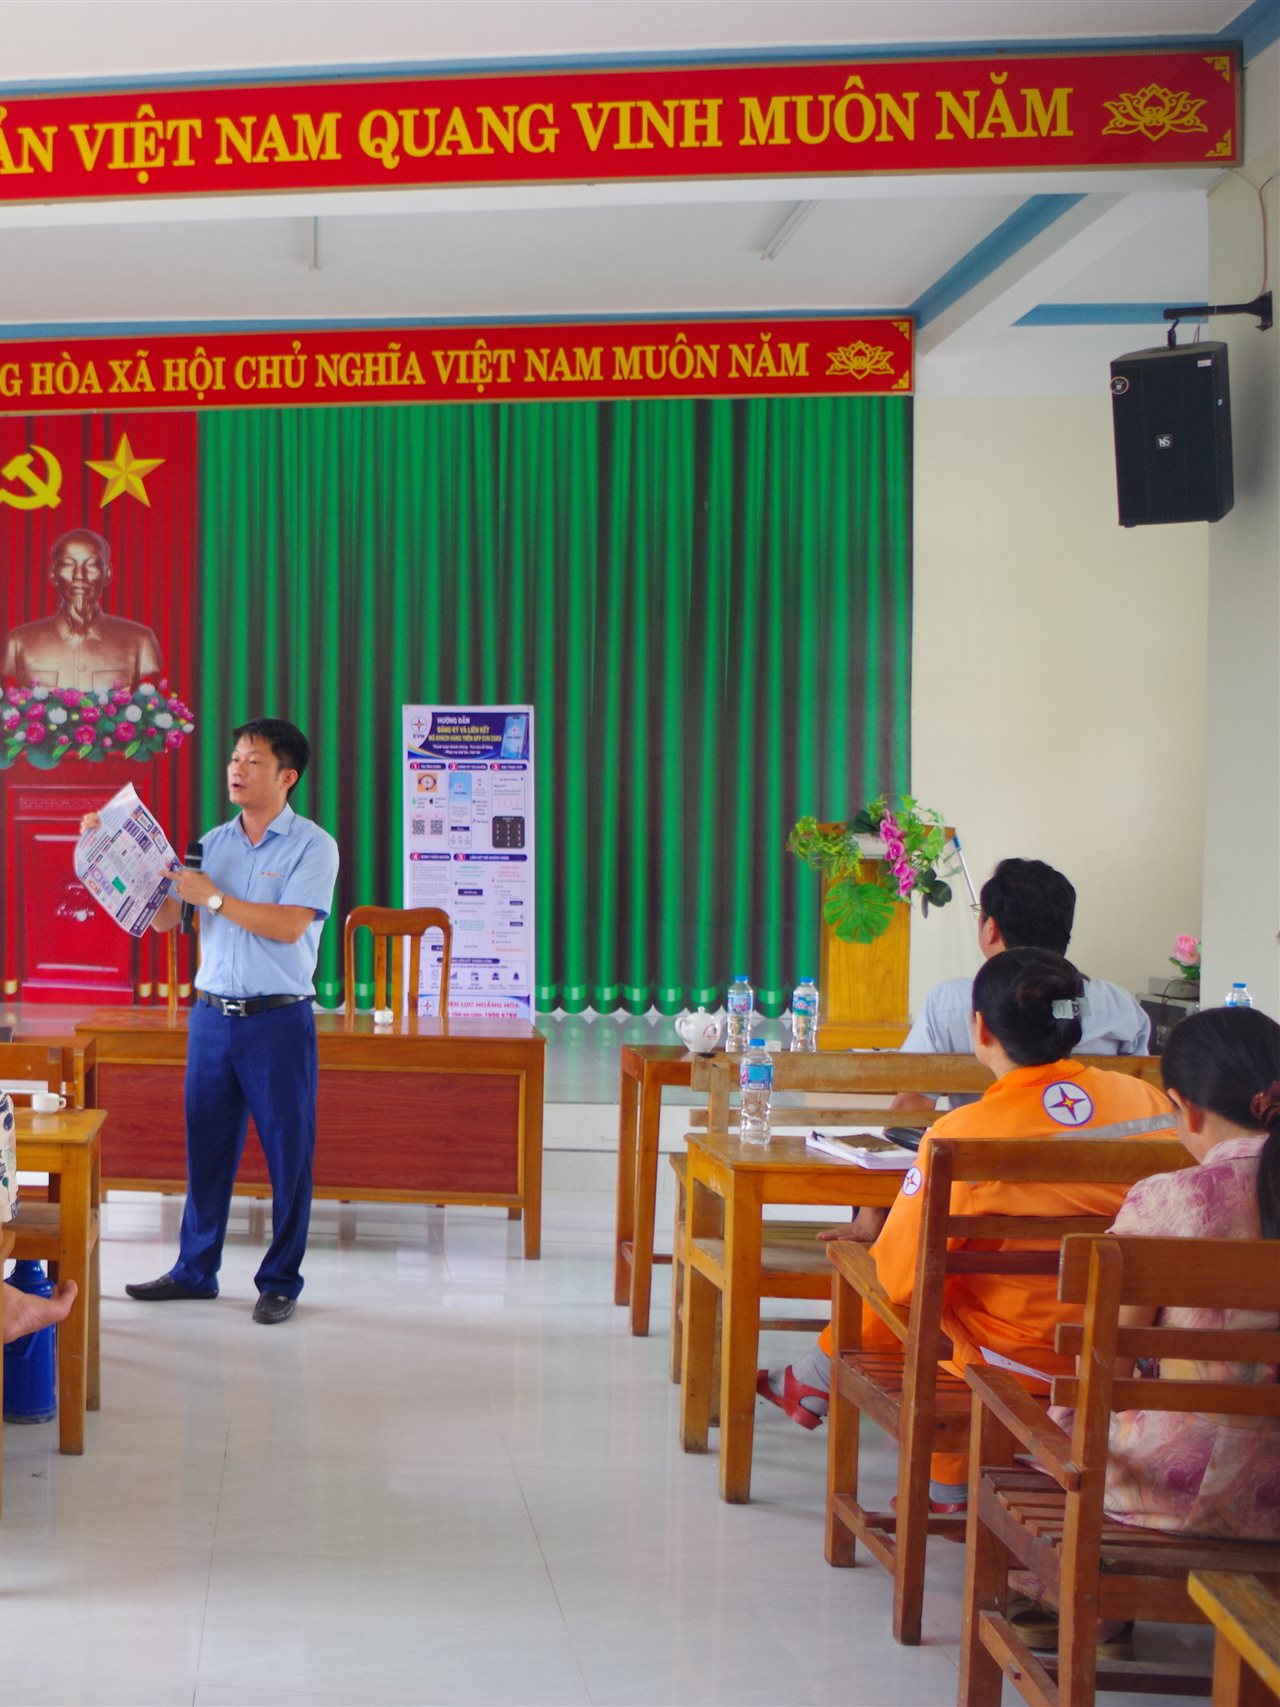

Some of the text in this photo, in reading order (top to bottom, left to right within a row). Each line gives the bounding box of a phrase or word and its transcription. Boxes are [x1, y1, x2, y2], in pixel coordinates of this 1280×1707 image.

[68, 103, 203, 184] VIỆT
[214, 112, 342, 165] NAM
[358, 103, 560, 170] QUANG
[571, 98, 724, 152] VINH
[738, 75, 920, 146] MUÔN
[935, 71, 1074, 140] NĂM
[30, 351, 103, 395] HÒA
[108, 349, 156, 393] XÃ
[163, 346, 226, 401] HỘI
[234, 340, 308, 390] CHỦ
[314, 342, 426, 388] NGHĨA
[431, 338, 516, 393] VIỆT
[524, 347, 604, 382] NAM
[612, 332, 721, 380] MUÔN
[728, 332, 810, 378] NĂM
